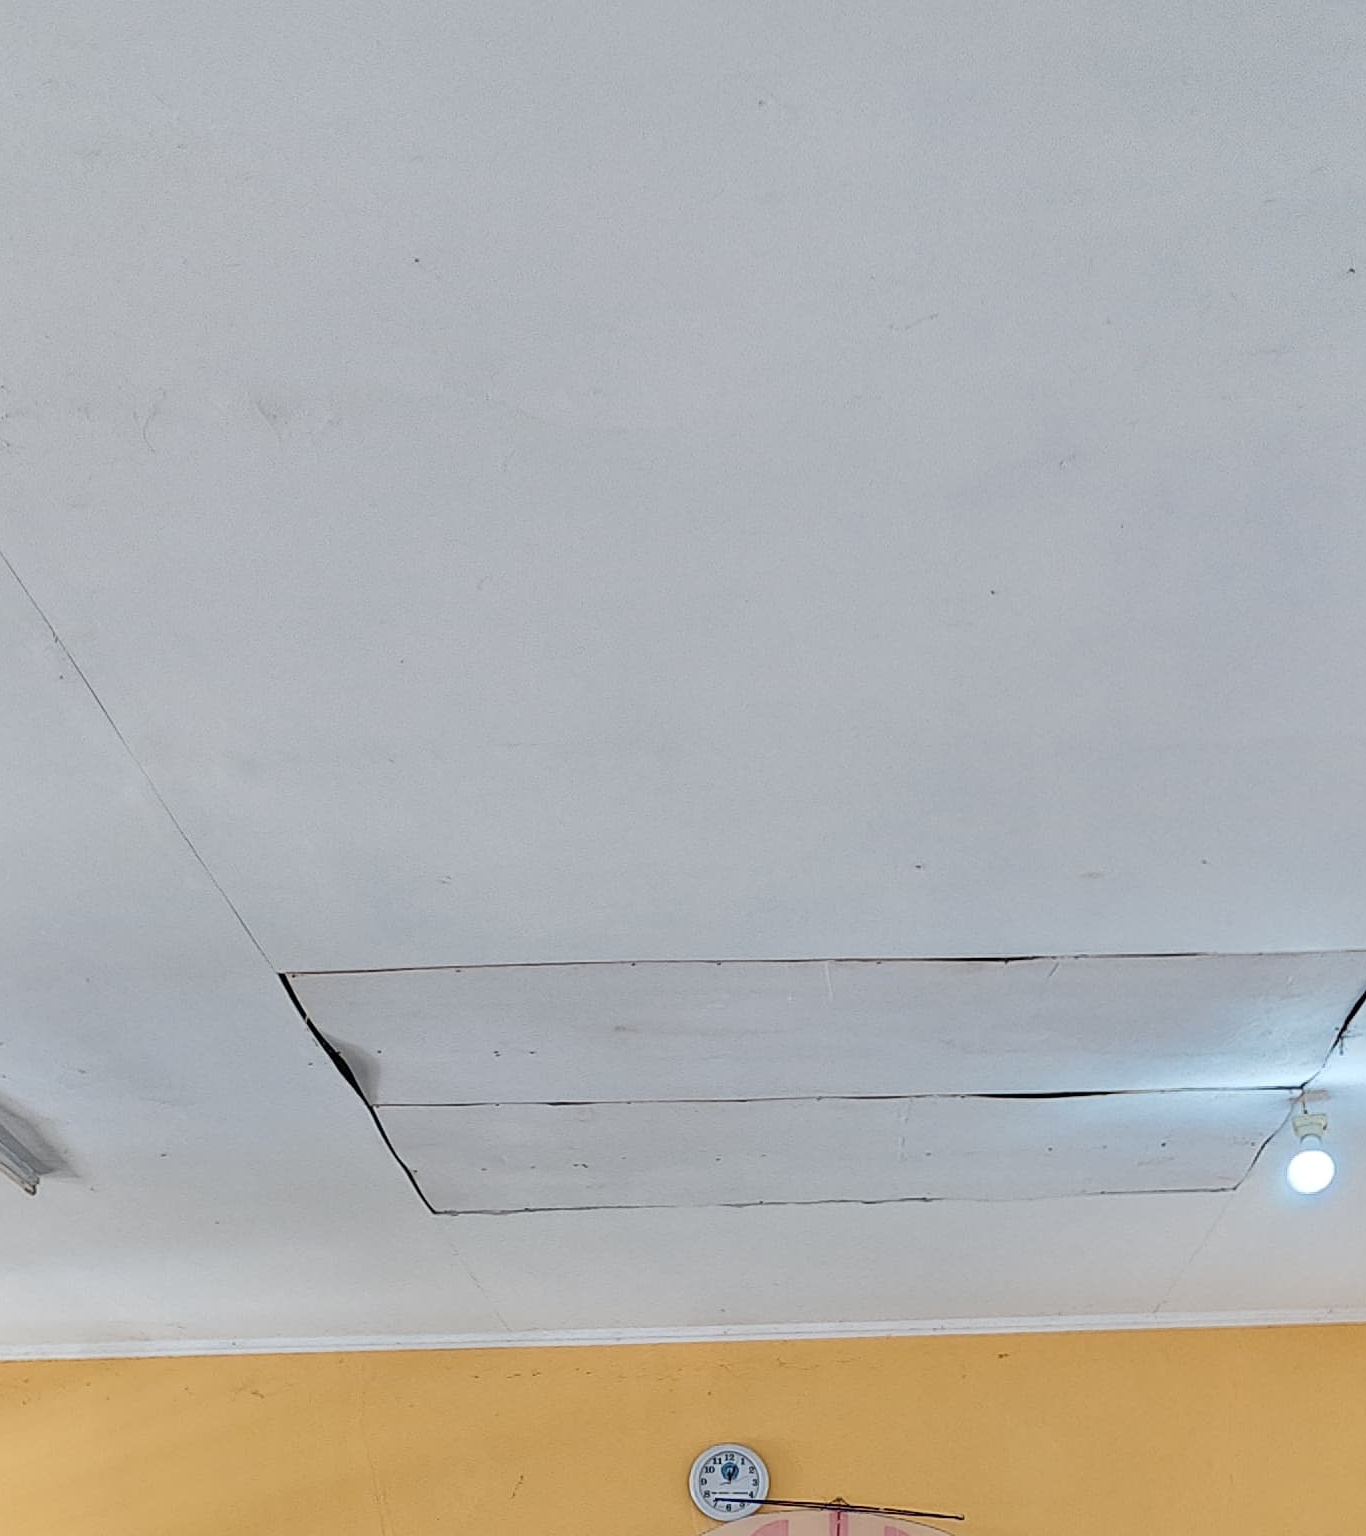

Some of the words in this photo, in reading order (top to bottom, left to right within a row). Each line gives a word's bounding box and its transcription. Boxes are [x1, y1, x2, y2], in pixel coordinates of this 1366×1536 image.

[712, 1457, 722, 1465] 11
[725, 1453, 735, 1462] 12
[704, 1465, 715, 1474] 10
